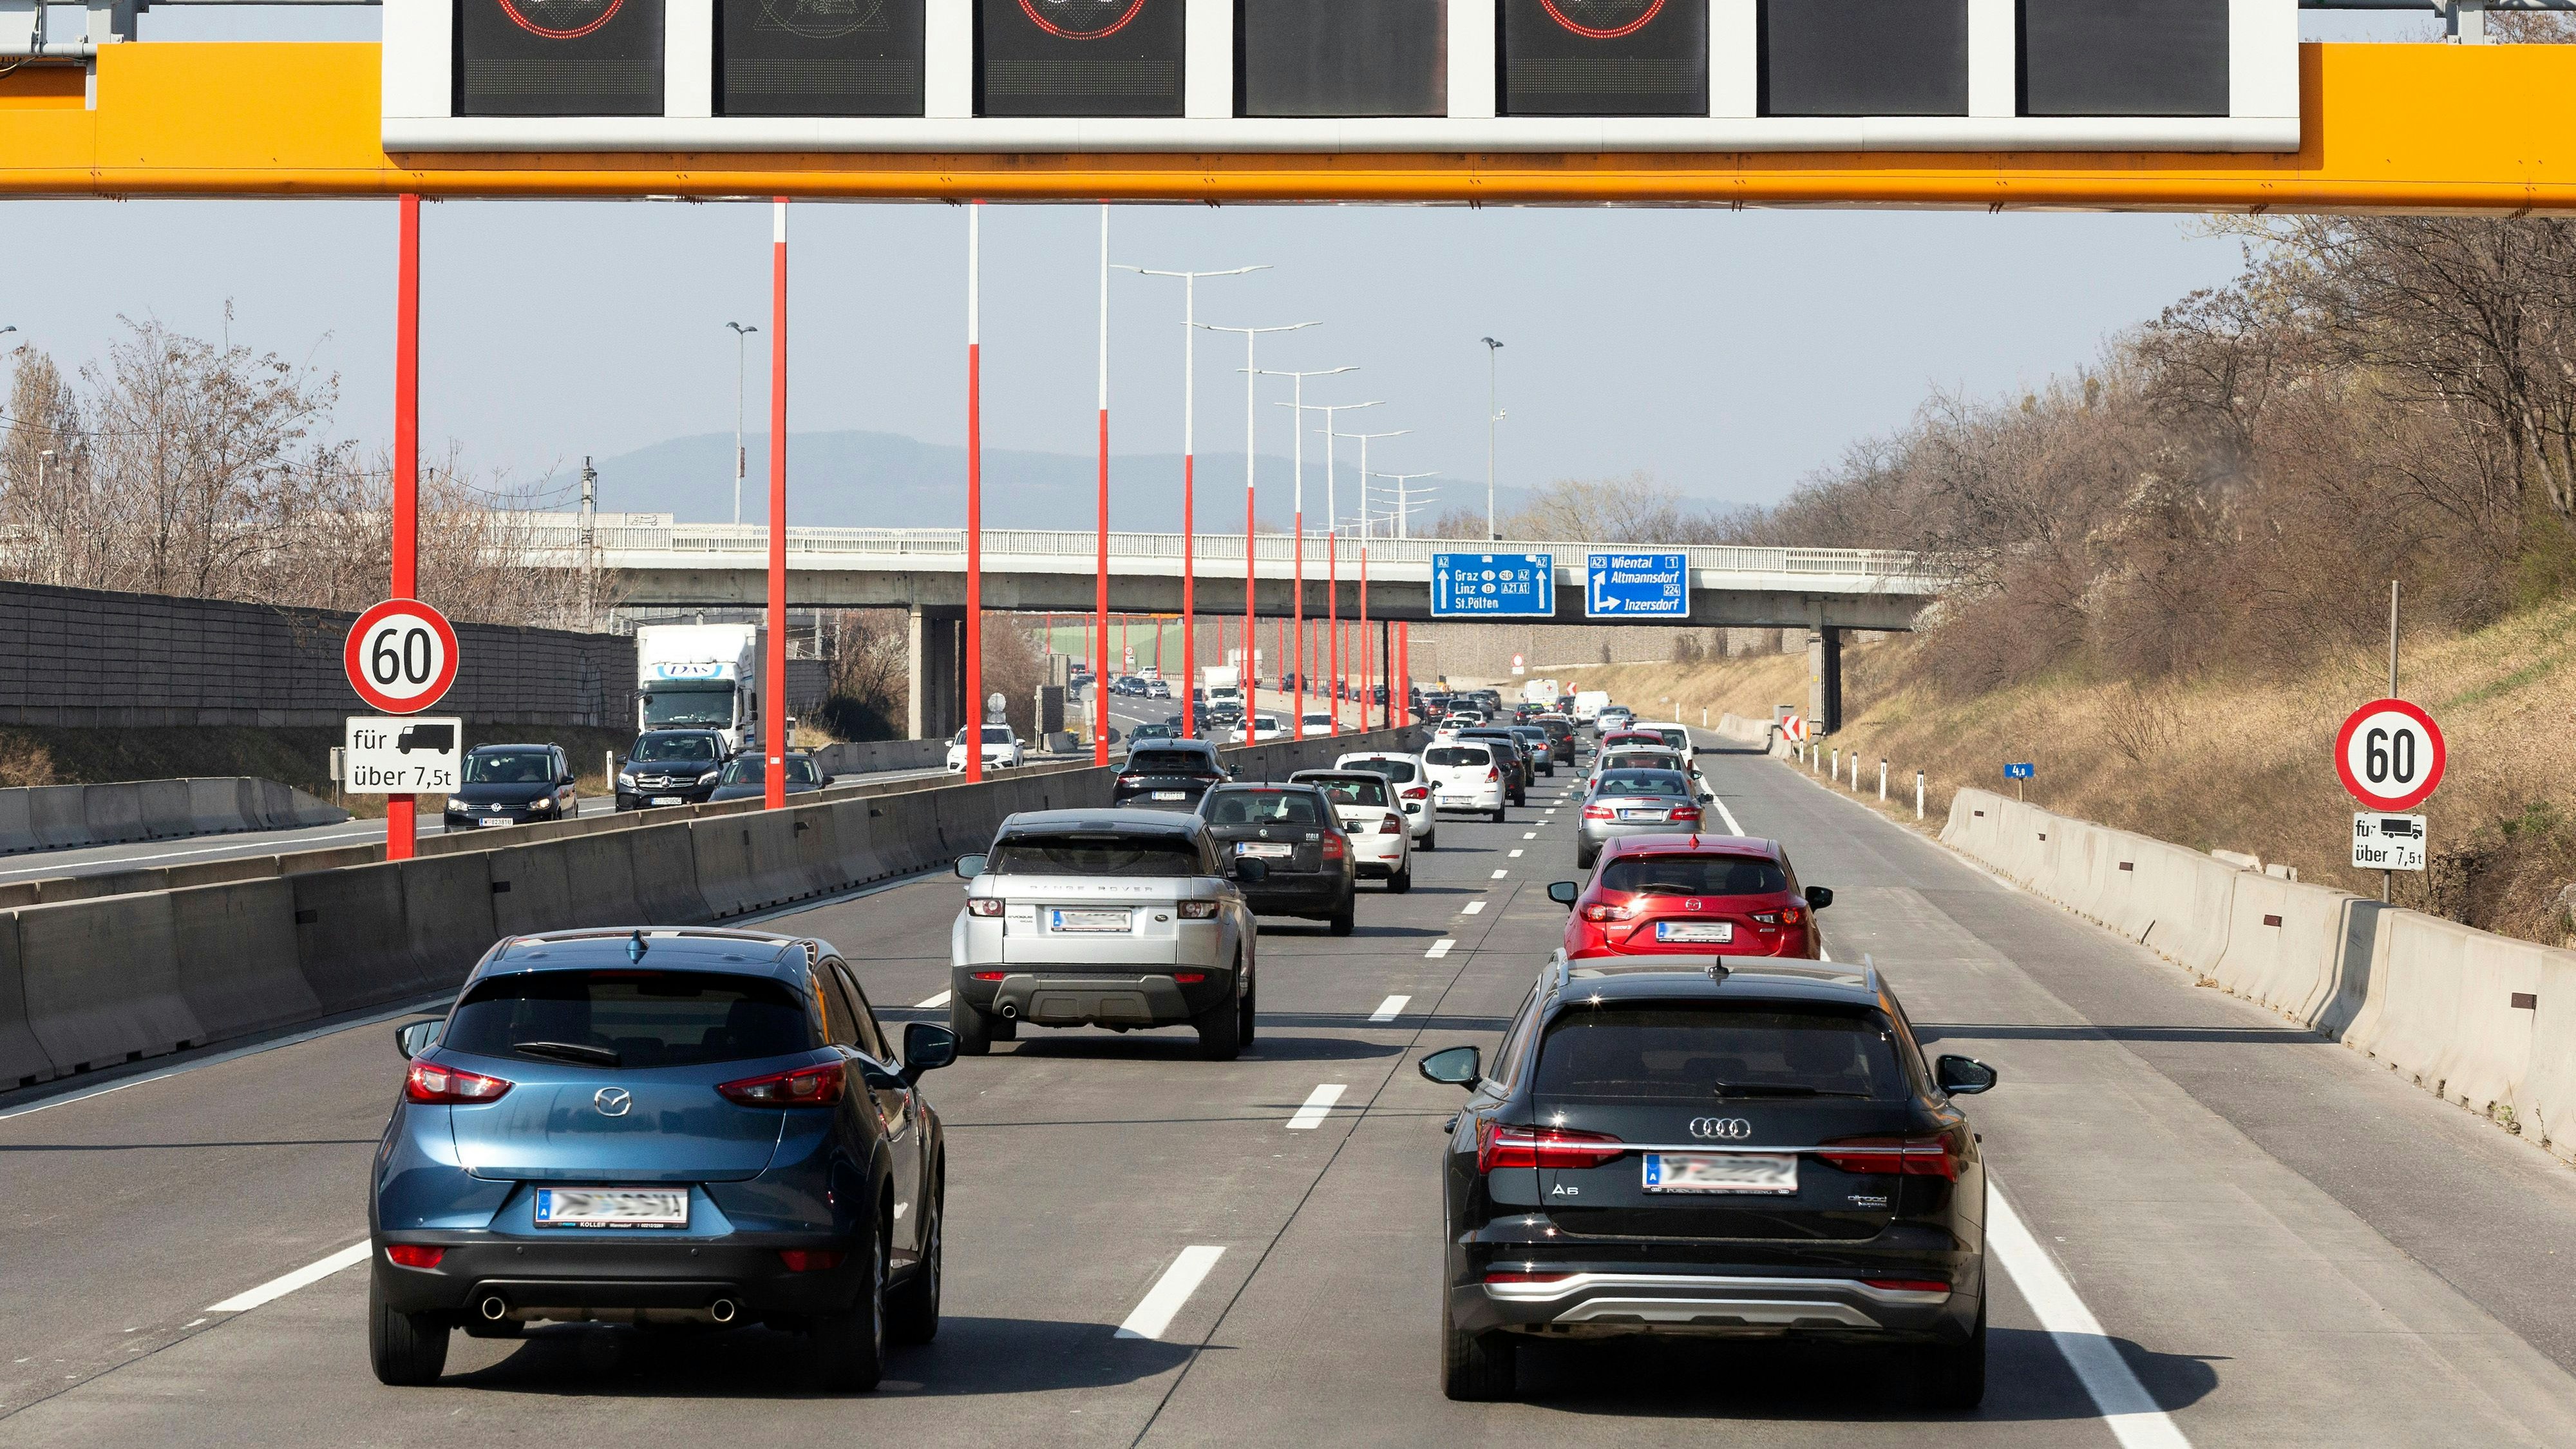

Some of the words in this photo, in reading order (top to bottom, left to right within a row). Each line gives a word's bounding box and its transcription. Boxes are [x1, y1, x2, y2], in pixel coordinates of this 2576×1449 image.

[1537, 558, 1546, 567] A2
[1592, 558, 1606, 567] A23
[1611, 556, 1653, 569] Wiental
[1455, 569, 1479, 582] Graz
[1519, 571, 1529, 580] A2
[1611, 571, 1680, 583] Altmannsdorf
[1455, 583, 1475, 594] Linz
[1502, 583, 1517, 593] A21
[1519, 583, 1528, 593] A1
[1665, 586, 1680, 594] 224
[1624, 598, 1680, 611] Inzersdorf
[372, 627, 431, 685] 60
[670, 666, 708, 675] DAS
[354, 729, 387, 750] für
[2366, 728, 2415, 784] 60
[354, 765, 406, 786] über
[2012, 765, 2025, 777] 4,0
[2356, 844, 2388, 862] über
[1551, 1184, 1578, 1195] A6
[1847, 1195, 1887, 1203] allroad
